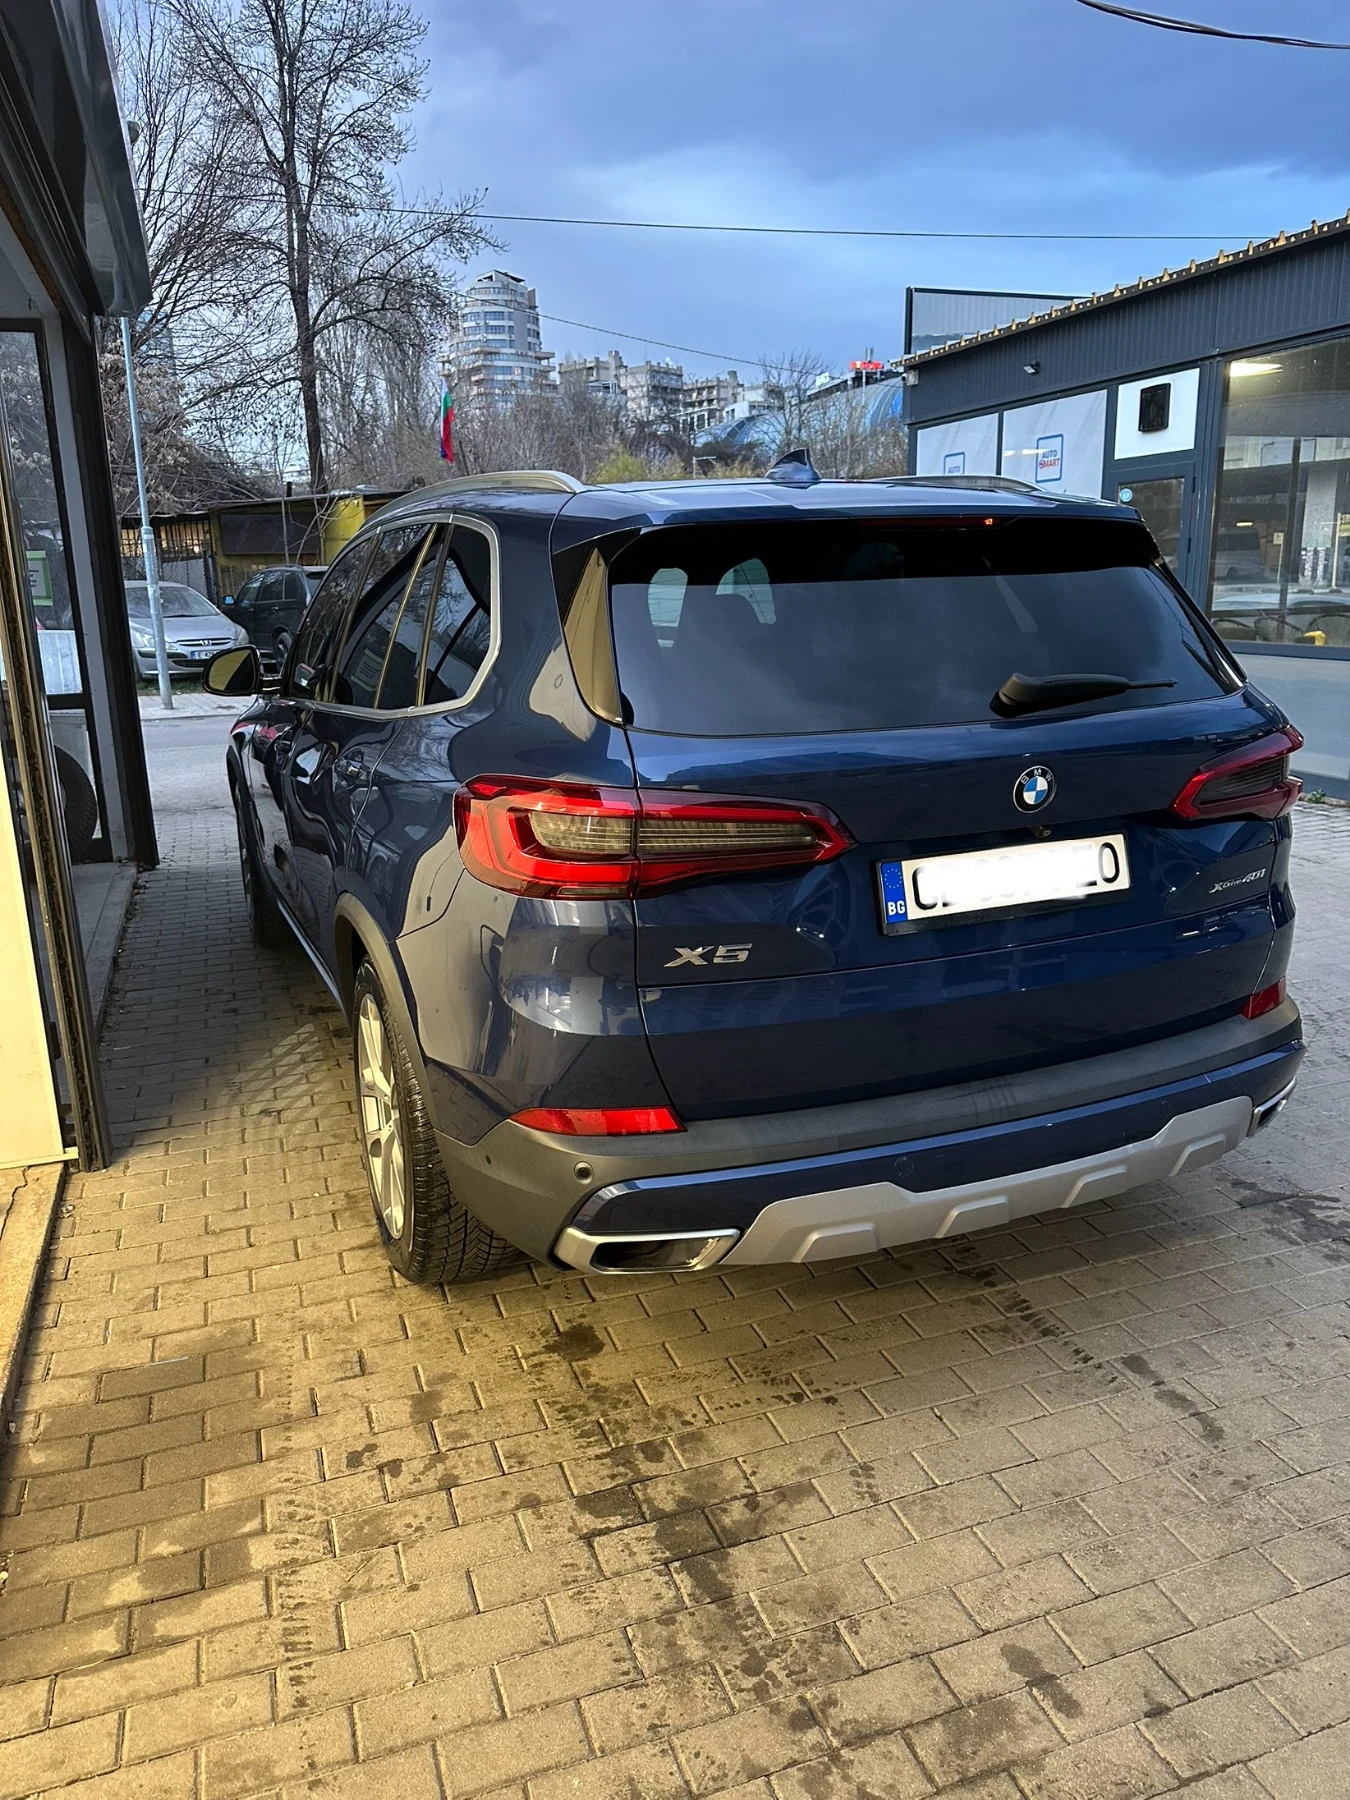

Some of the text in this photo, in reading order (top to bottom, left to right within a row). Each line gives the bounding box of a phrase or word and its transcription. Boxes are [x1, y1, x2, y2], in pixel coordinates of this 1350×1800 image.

[1041, 450, 1057, 459] AUTO
[948, 466, 960, 474] AUTO
[1020, 768, 1053, 785] BMW
[888, 900, 906, 916] BG
[663, 943, 753, 968] X5
